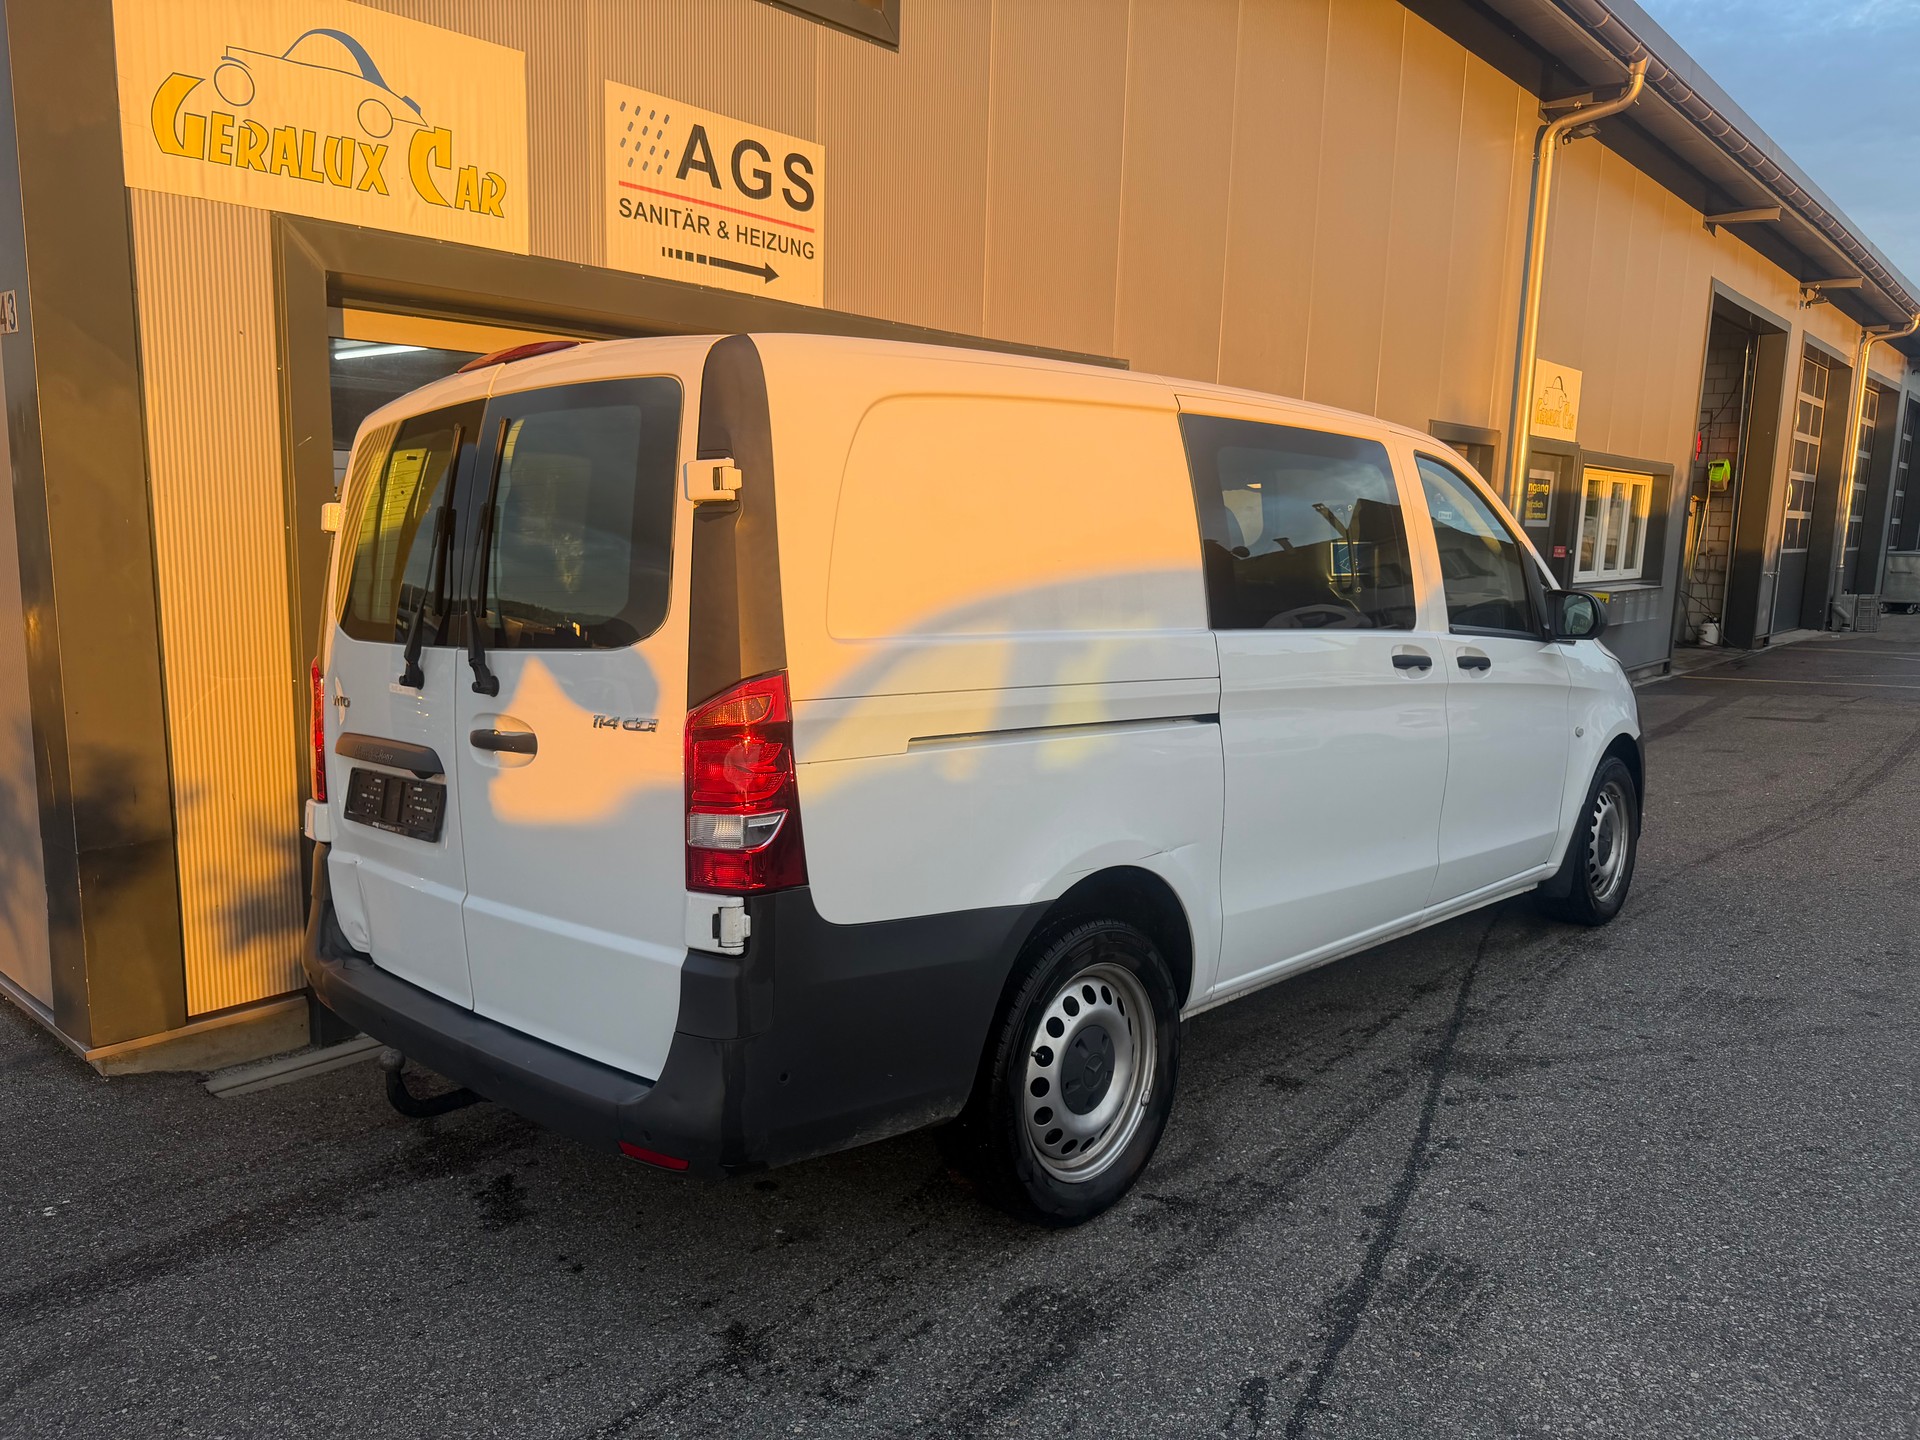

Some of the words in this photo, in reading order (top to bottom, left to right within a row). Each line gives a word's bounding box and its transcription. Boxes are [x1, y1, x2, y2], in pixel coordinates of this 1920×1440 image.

[151, 72, 389, 196] GERALUX
[408, 127, 507, 218] CAR
[676, 123, 815, 213] AGS
[619, 197, 710, 236] SANITÄR
[717, 220, 730, 240] &
[736, 224, 814, 260] HEIZUNG
[0, 293, 16, 331] 43
[1527, 482, 1550, 496] ngang
[593, 713, 620, 730] 114
